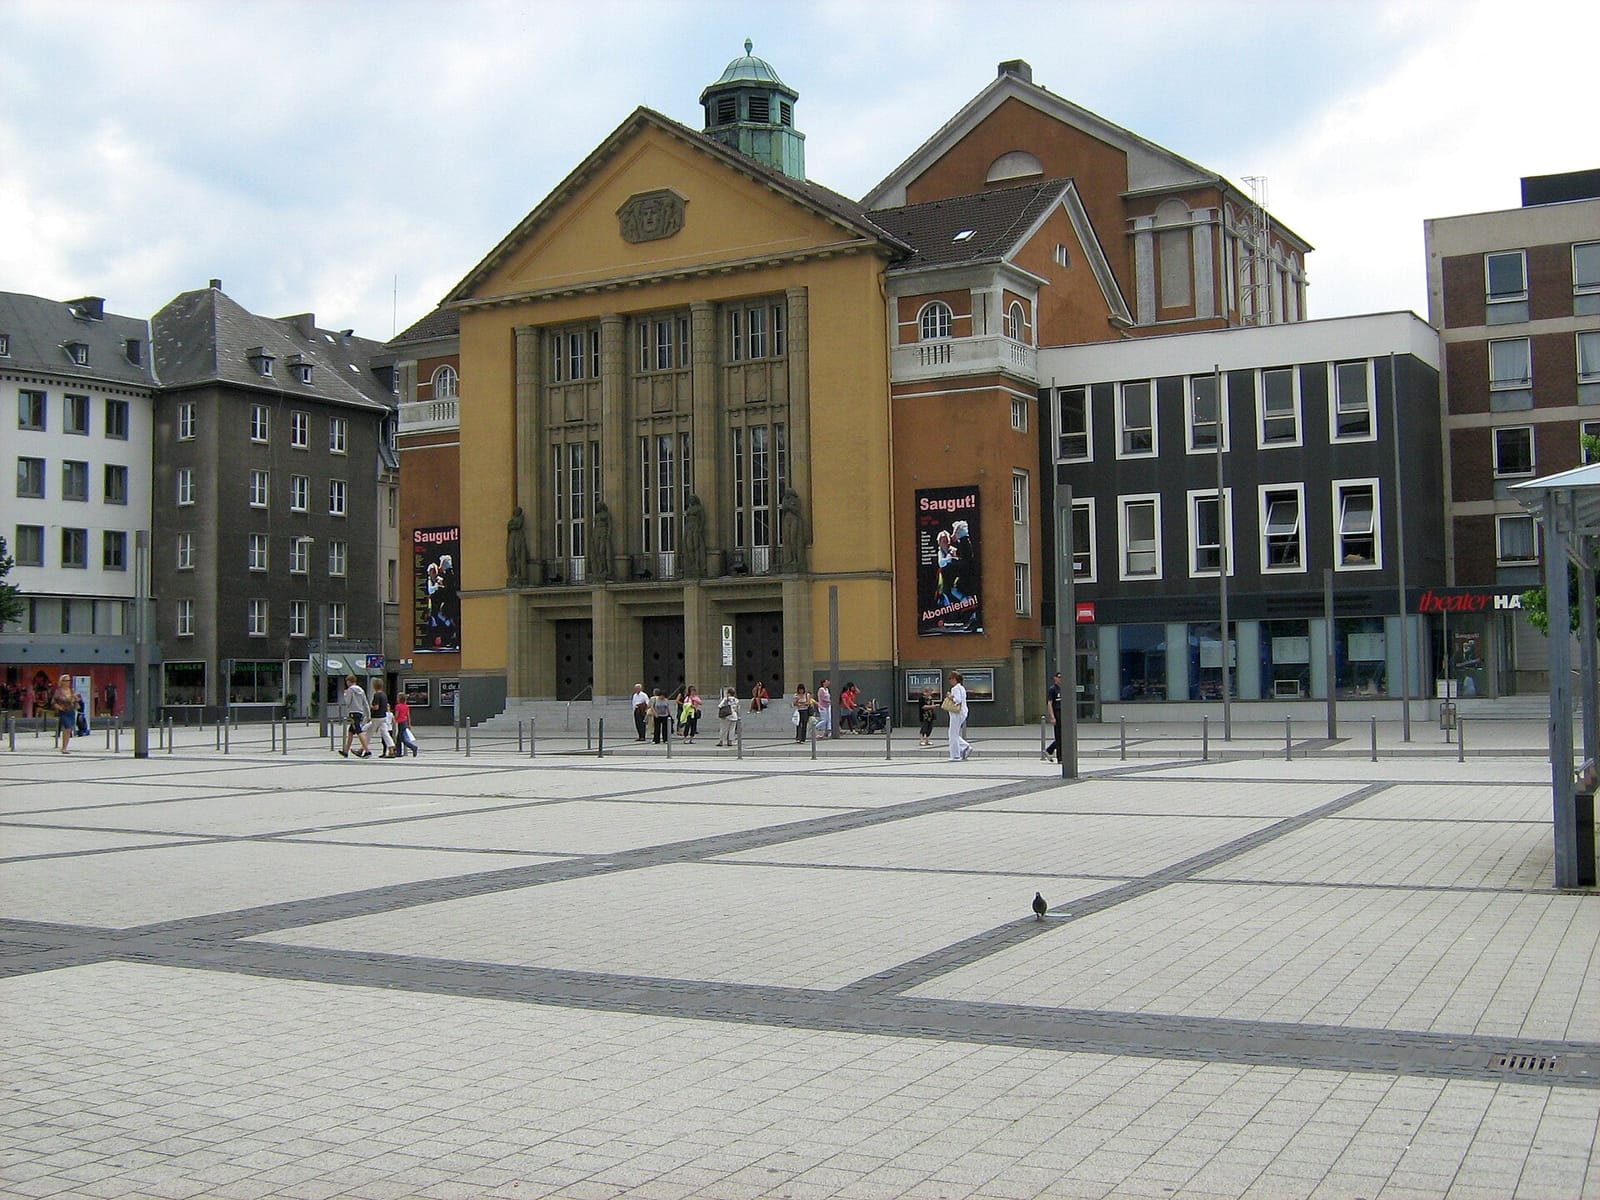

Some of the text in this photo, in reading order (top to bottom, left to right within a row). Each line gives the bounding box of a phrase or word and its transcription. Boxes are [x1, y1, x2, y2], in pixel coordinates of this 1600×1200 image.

[919, 495, 976, 512] Saugut!
[414, 528, 459, 545] Saugut!
[922, 595, 978, 621] Abonnieren!
[1419, 590, 1522, 612] theater HA
[909, 675, 940, 685] Thatr
